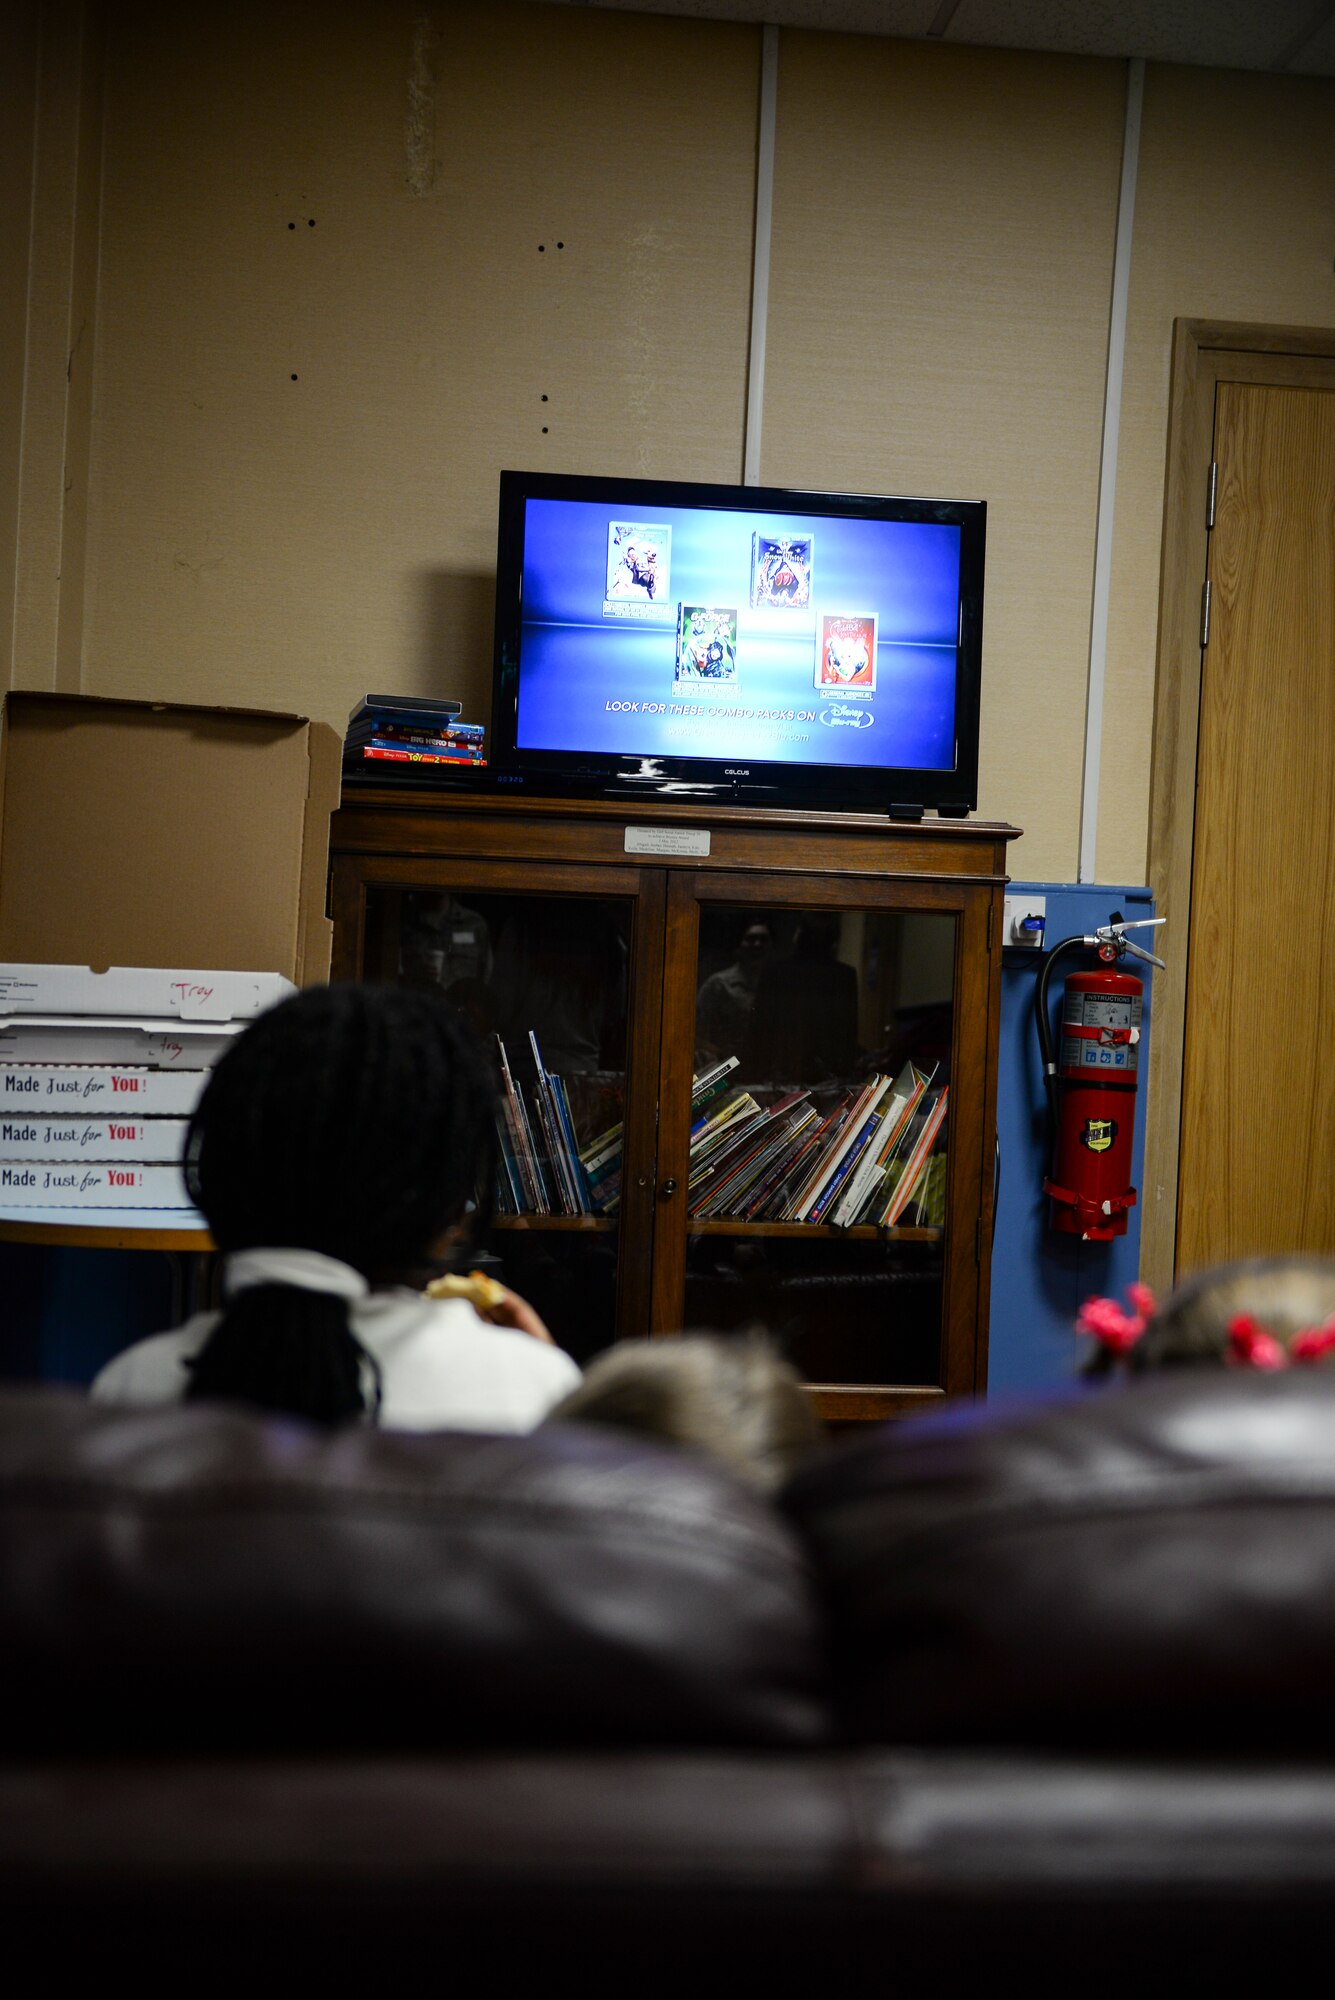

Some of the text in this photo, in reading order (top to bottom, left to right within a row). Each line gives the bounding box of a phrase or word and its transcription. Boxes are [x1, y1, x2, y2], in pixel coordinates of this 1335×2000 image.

[605, 700, 816, 722] LOOK FOR THESE COMBO PACKS ON
[410, 736, 424, 744] BIG
[426, 738, 447, 747] HERO
[408, 753, 423, 761] TOY
[175, 982, 214, 1005] Troy
[1086, 995, 1131, 1003] INSTRUCTIONS
[5, 1075, 40, 1092] Made
[46, 1078, 82, 1095] Just
[83, 1077, 105, 1098] for
[2, 1124, 37, 1141] Made
[43, 1126, 79, 1144] Just
[80, 1125, 102, 1146] for
[1, 1169, 37, 1187] Made
[43, 1172, 79, 1188] Just
[80, 1171, 102, 1192] for
